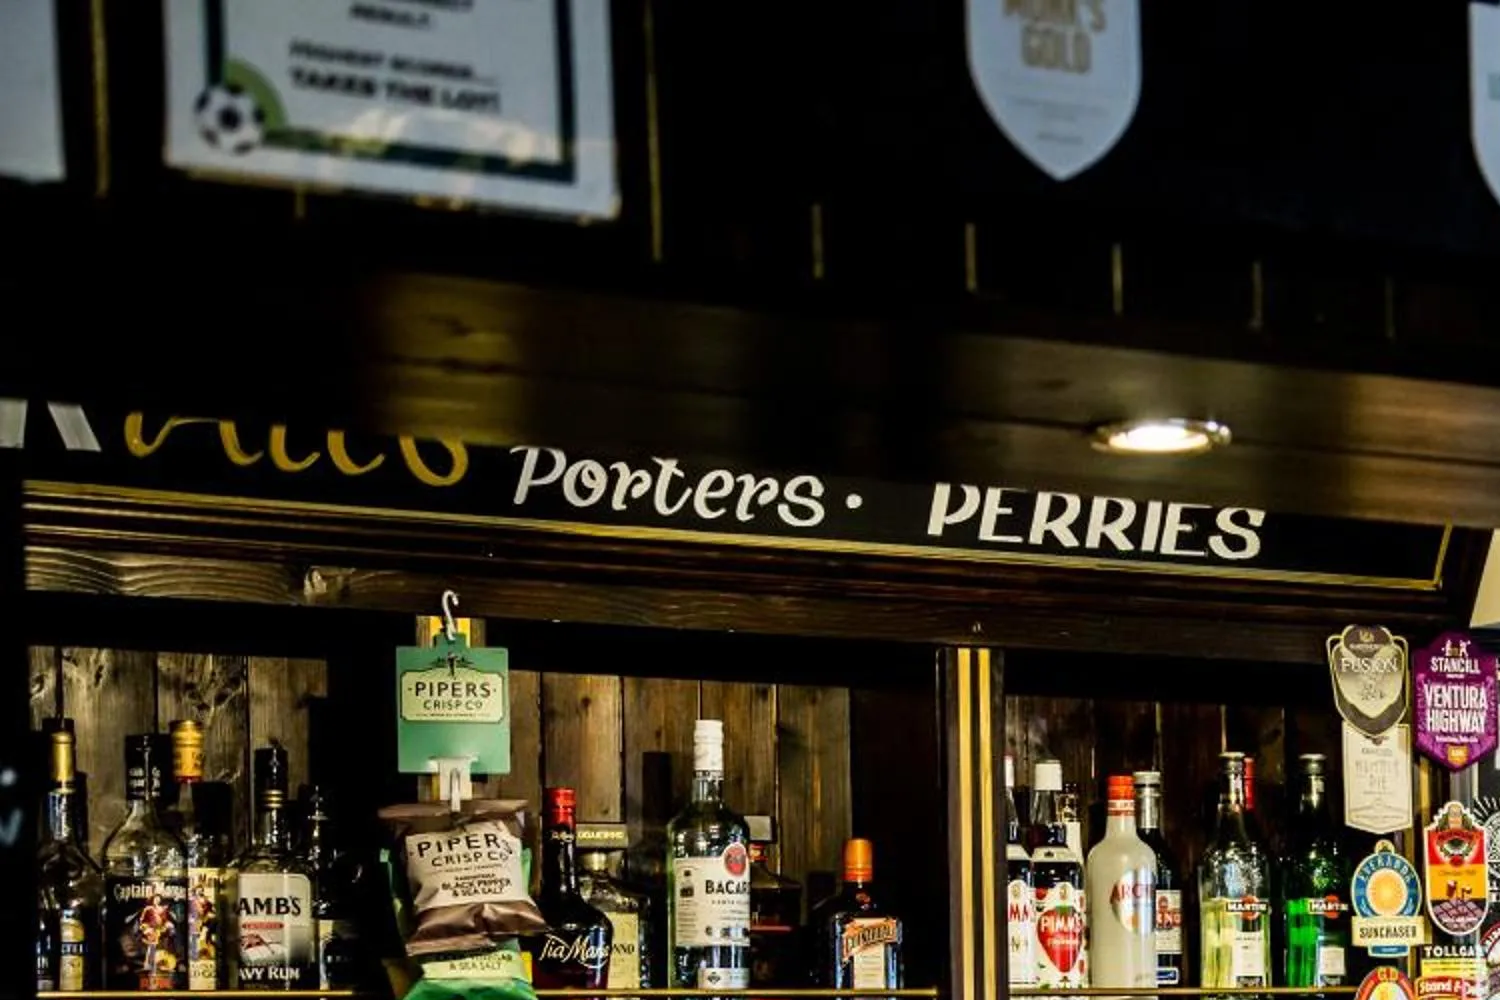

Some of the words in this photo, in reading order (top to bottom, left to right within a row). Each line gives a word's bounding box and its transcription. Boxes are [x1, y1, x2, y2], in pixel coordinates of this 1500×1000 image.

[1022, 23, 1092, 75] GOLD
[509, 444, 825, 528] Porters
[928, 481, 1267, 561] PERRIES
[1430, 655, 1481, 675] STANCILL
[414, 680, 491, 699] PIPERS
[1424, 682, 1488, 709] VENTURA
[423, 699, 463, 711] CRISP
[1426, 707, 1486, 734] HIGHWAY
[431, 852, 483, 868] CRISP
[705, 878, 750, 896] BACAR
[238, 896, 301, 916] AMB'S
[1359, 924, 1418, 940] SUNCHASER
[539, 932, 566, 962] Tia
[239, 966, 264, 982] AVY
